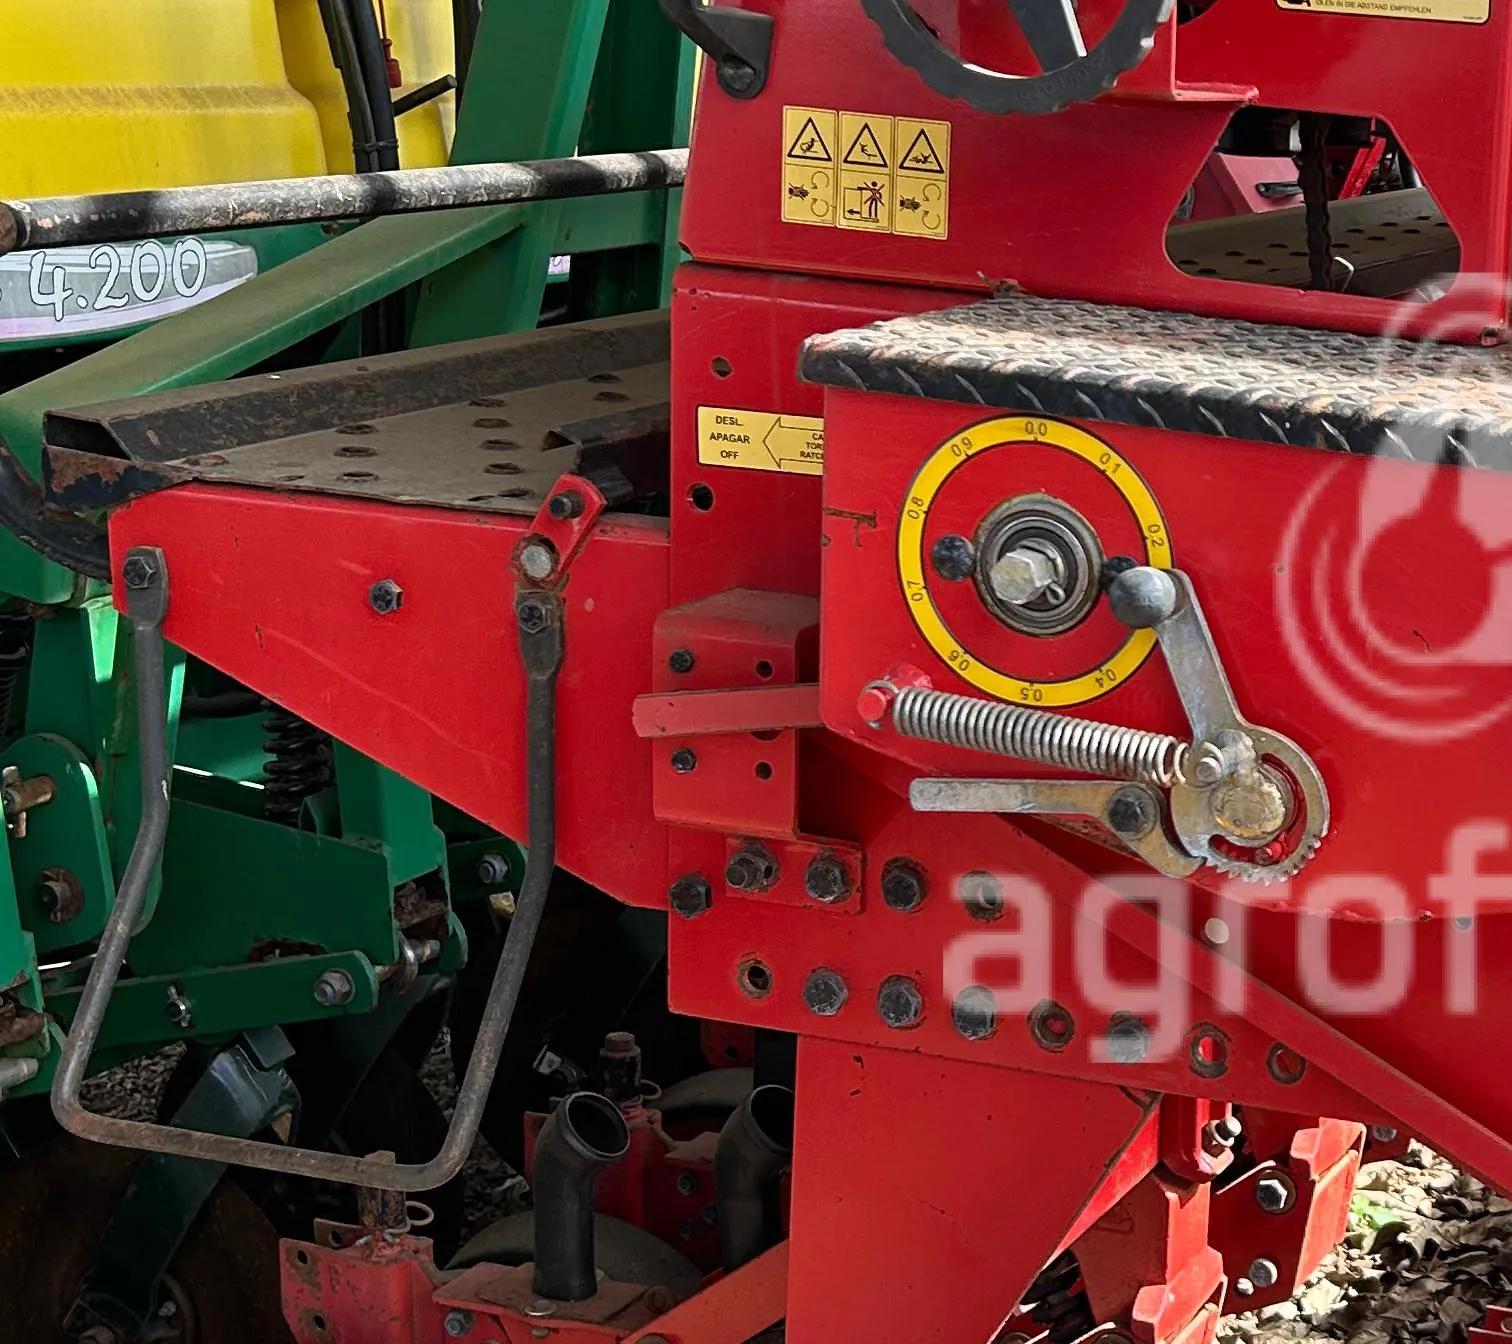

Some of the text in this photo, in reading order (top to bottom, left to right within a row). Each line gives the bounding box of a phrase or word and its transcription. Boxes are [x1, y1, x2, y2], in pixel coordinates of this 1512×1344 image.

[30, 238, 207, 321] 4.200
[709, 432, 751, 444] APAGAR
[1024, 421, 1048, 437] 0.0
[720, 450, 740, 460] OFF
[950, 437, 973, 458] 0.9
[1099, 452, 1122, 474] 0.1
[907, 496, 924, 520] 0.8
[1146, 523, 1165, 548] 0.2
[907, 580, 924, 601] 0.7
[1095, 668, 1117, 688] 0.4
[1019, 687, 1043, 702] 0.5
